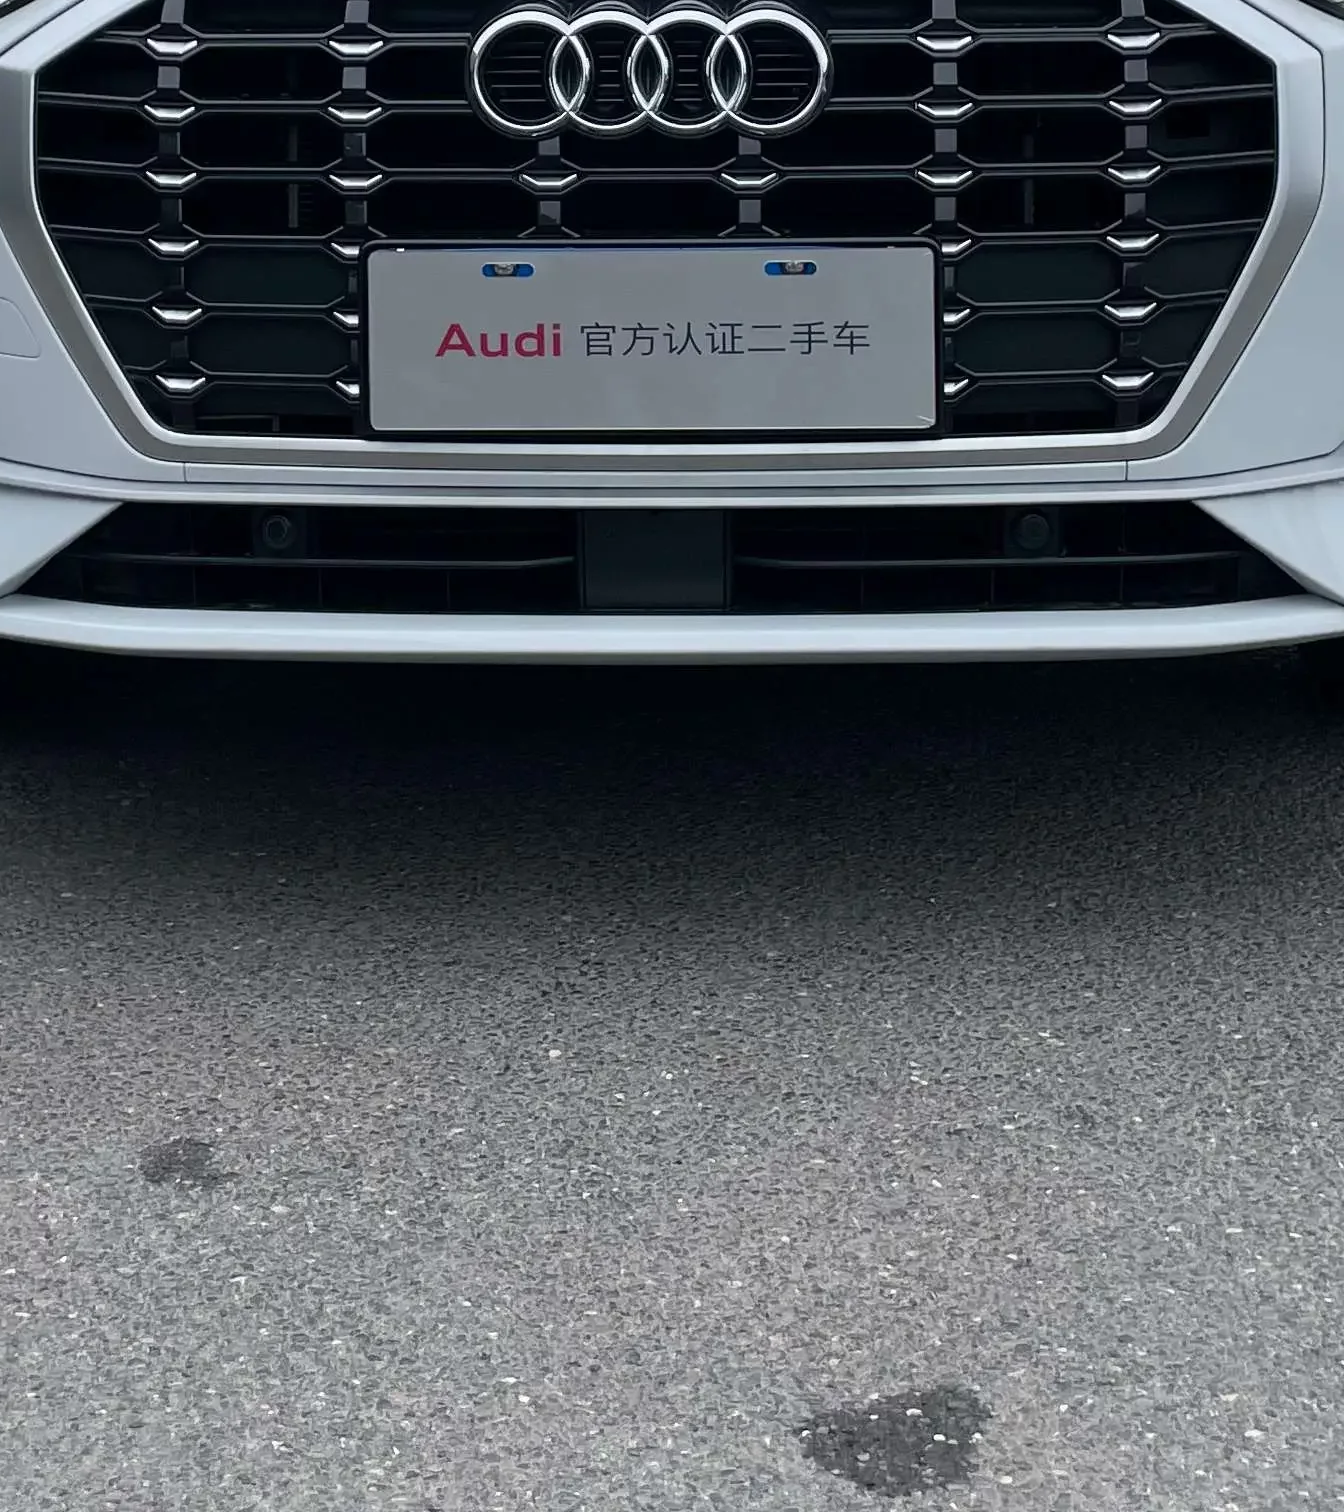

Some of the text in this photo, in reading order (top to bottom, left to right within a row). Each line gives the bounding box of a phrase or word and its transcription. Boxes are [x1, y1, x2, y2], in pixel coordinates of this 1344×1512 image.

[435, 320, 871, 359] Audi 官方认证二手车
